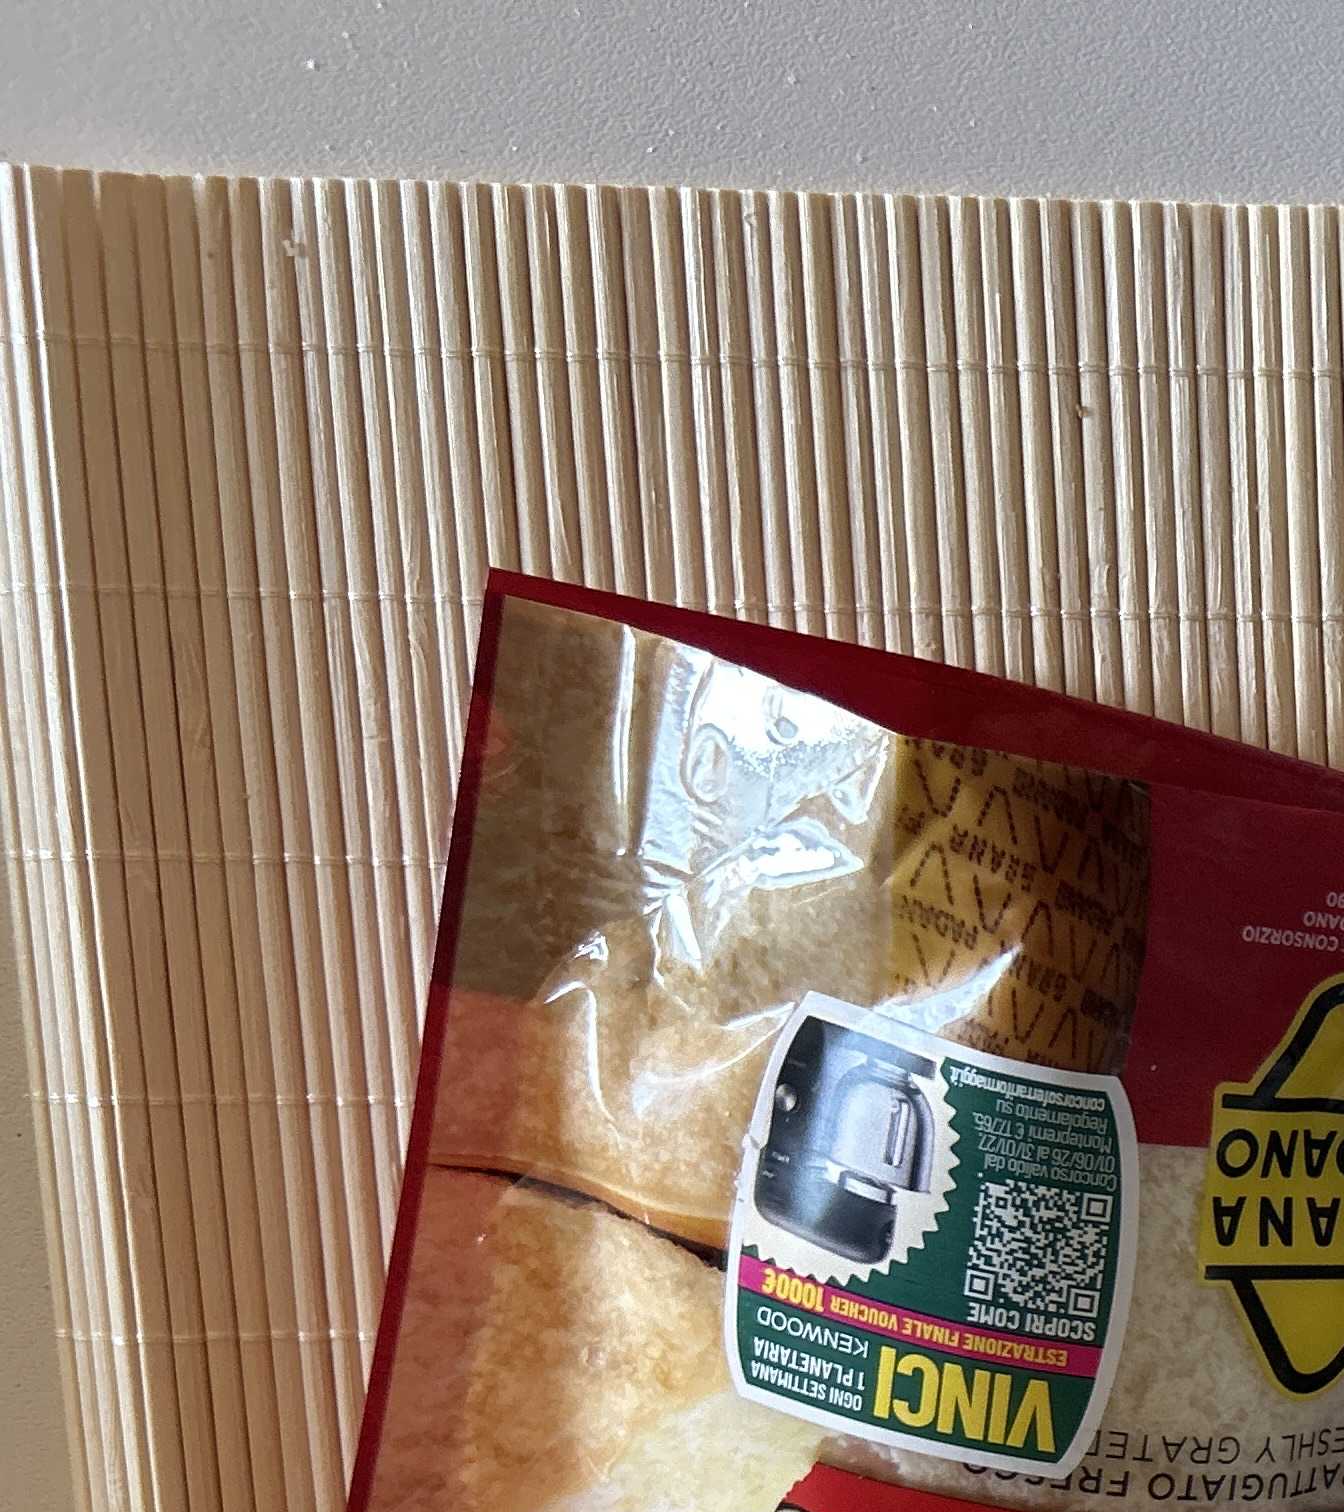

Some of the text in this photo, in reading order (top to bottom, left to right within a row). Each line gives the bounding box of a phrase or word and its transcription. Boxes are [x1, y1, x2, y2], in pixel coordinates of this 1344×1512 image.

[1241, 925, 1339, 951] CONSORZIO
[996, 1100, 1107, 1134] Regolamento su
[1029, 1124, 1112, 1154] Montepremi
[1037, 1147, 1050, 1160] al
[984, 1153, 1117, 1191] Concorso valido dal
[1053, 1148, 1115, 1172] 01/06/26
[756, 1306, 870, 1359] KENWOOD
[761, 1267, 1069, 1367] ESTRAZIONE FINALE VOUCHER 1000€
[966, 1302, 1096, 1340] SCOPRI COME
[753, 1336, 865, 1390] 1 PLANETARIA
[750, 1359, 863, 1412] OGNI SETTIMANA
[872, 1344, 1057, 1453] VINCI
